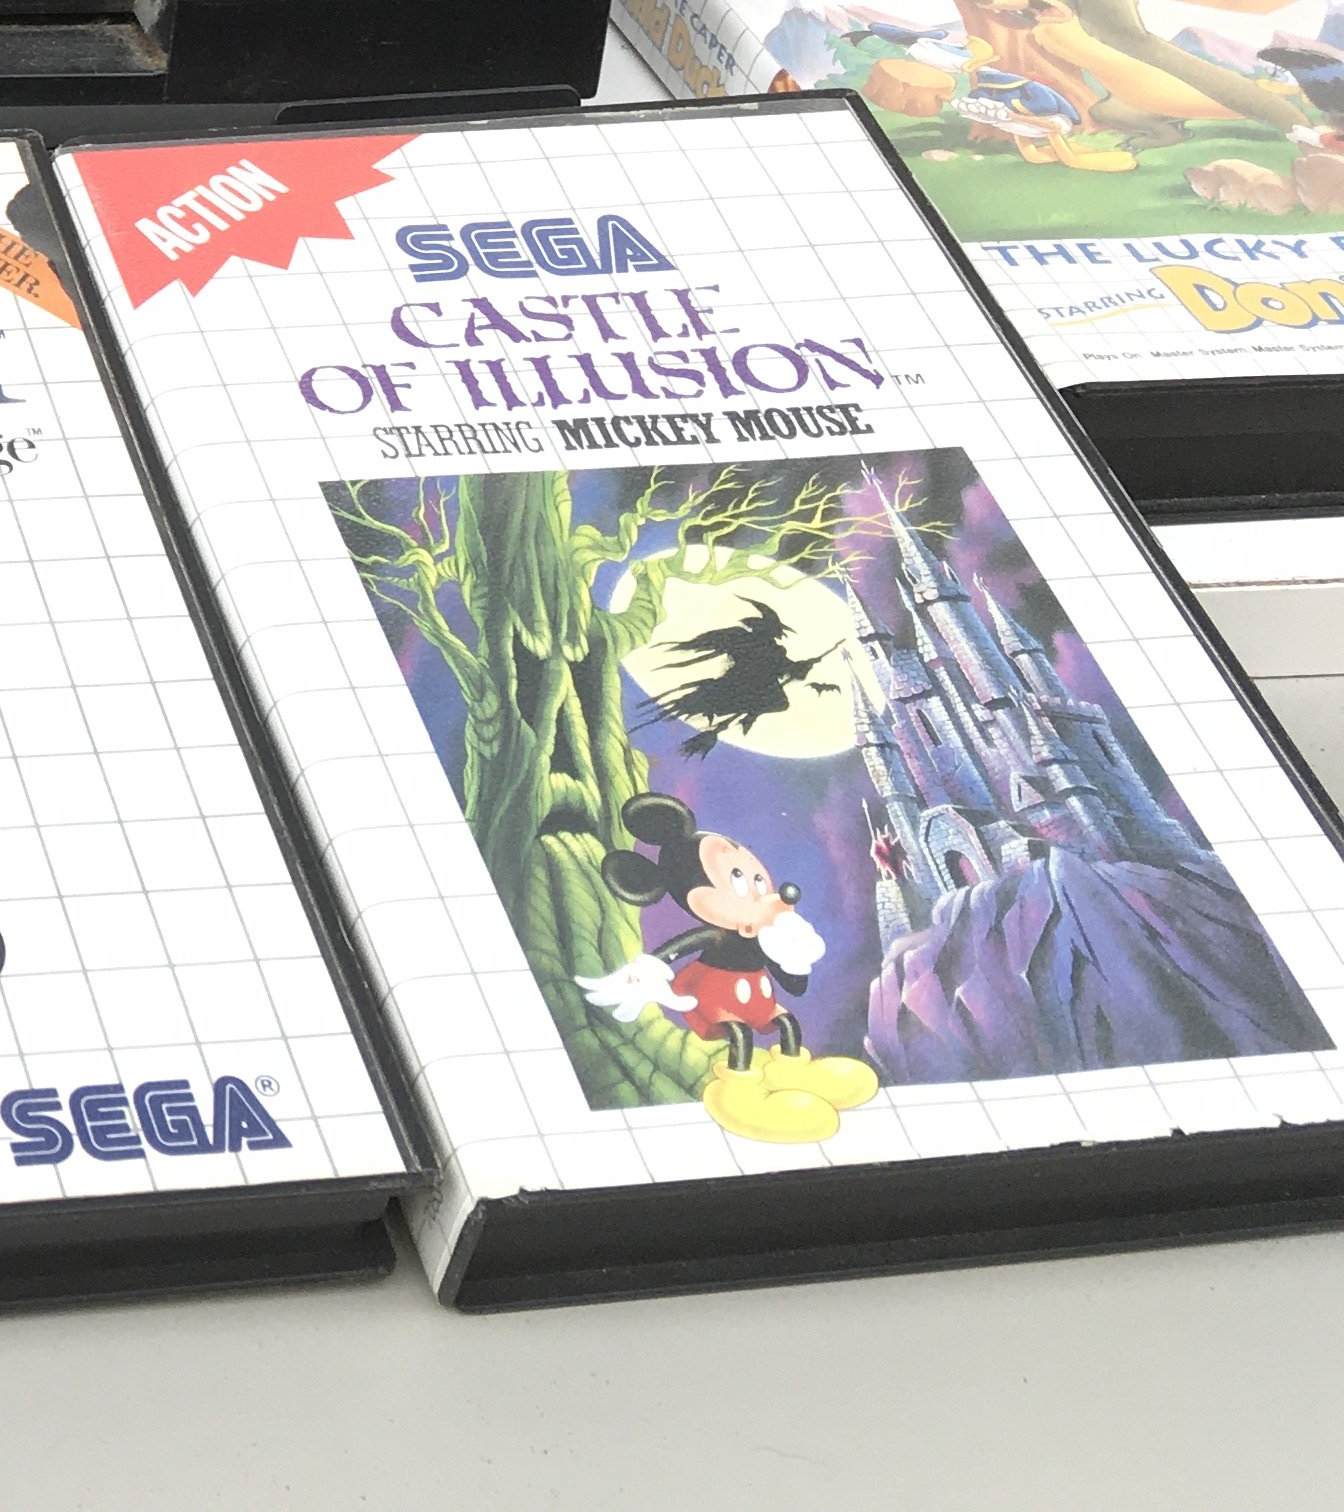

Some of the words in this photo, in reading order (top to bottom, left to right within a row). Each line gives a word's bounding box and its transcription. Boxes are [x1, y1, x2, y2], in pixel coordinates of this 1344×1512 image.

[690, 13, 737, 76] CAPER
[134, 158, 291, 262] ACTION
[395, 214, 677, 283] SEGA
[983, 242, 1113, 267] THE
[1122, 238, 1308, 263] LUCKY
[391, 284, 741, 350] CASTLE
[1037, 288, 1166, 320] STARRING
[299, 361, 415, 415] OF
[454, 338, 886, 414] ILLUSION
[1083, 352, 1118, 362] Plays
[1150, 349, 1194, 358] Master
[1252, 345, 1296, 353] Master
[371, 420, 544, 460] STARRING
[552, 409, 723, 453] MICKEY
[732, 402, 874, 443] MOUSE
[0, 1074, 294, 1167] SEGA
